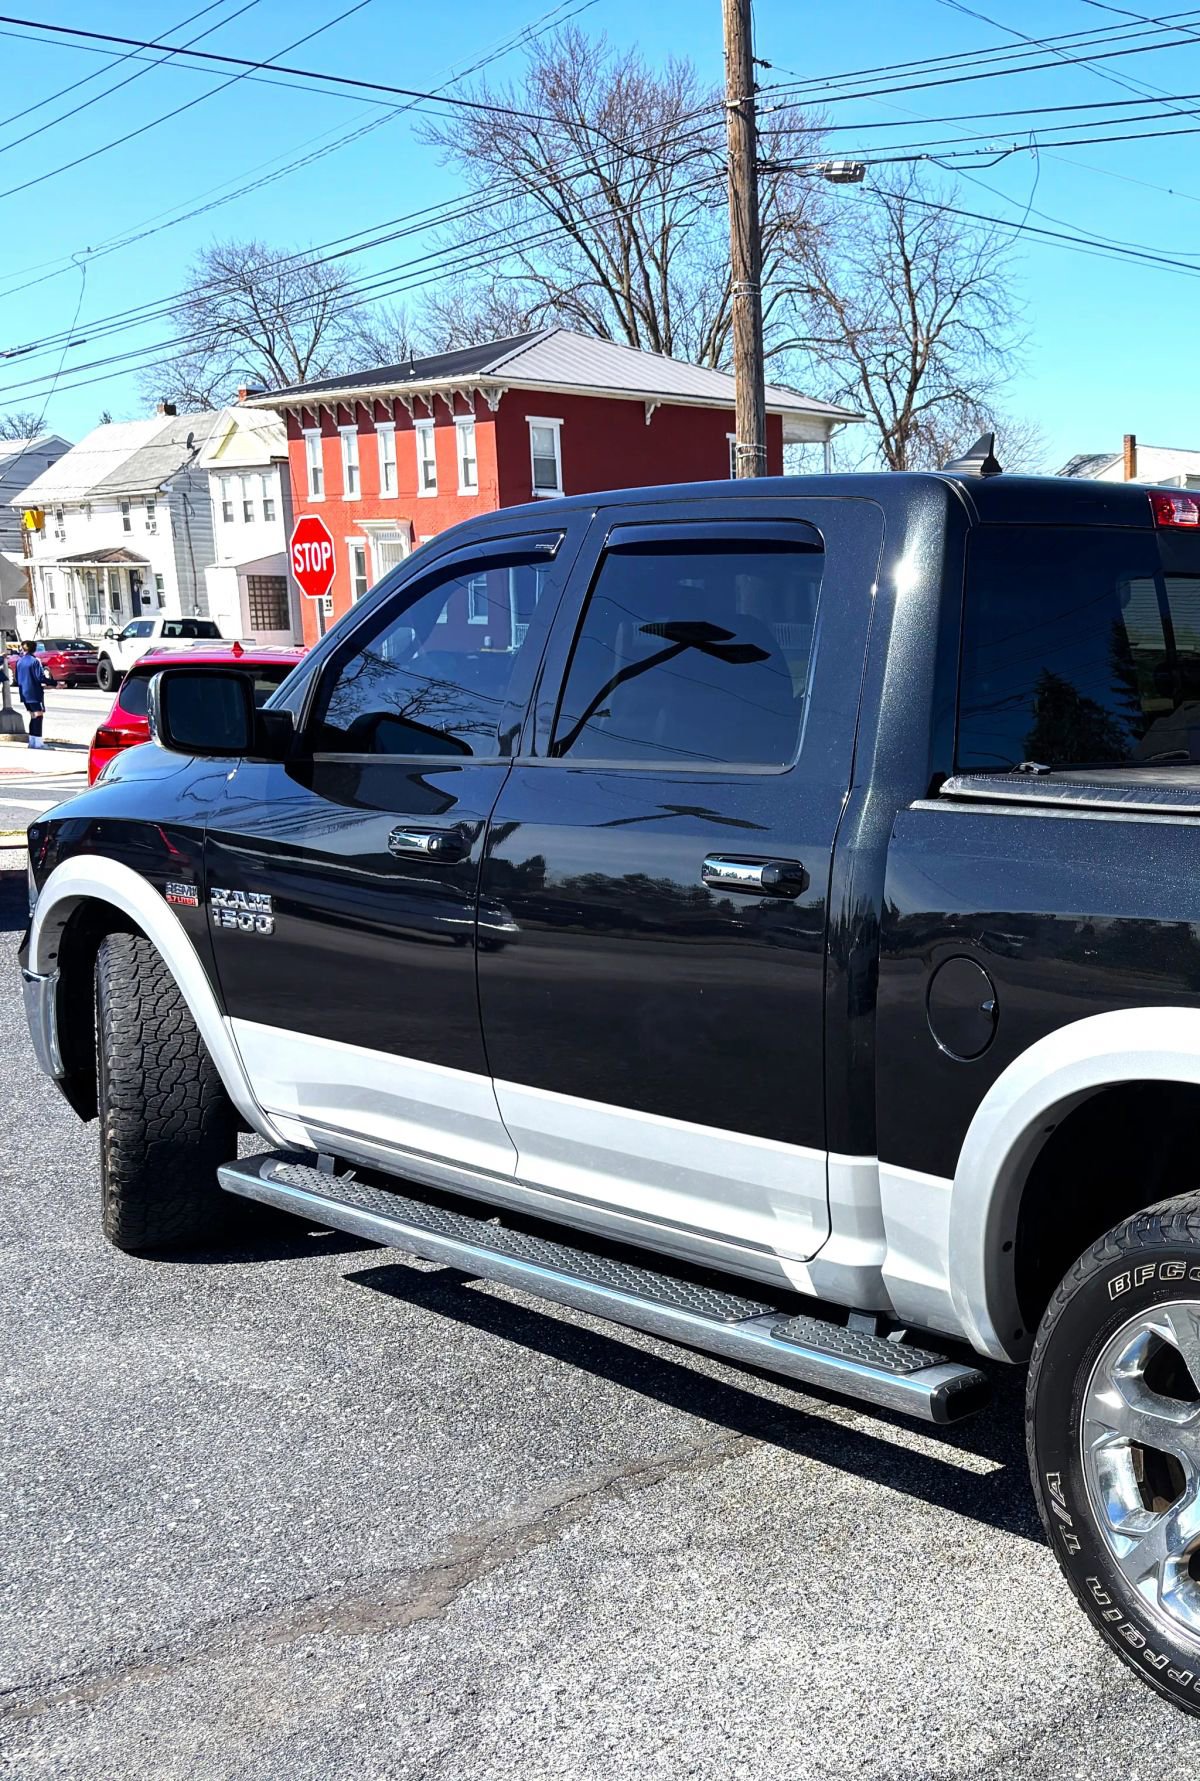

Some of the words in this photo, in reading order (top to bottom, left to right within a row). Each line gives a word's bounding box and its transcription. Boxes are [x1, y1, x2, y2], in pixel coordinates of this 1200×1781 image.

[294, 541, 331, 573] STOP
[210, 887, 272, 914] RAM
[211, 908, 275, 935] 1500
[1045, 1471, 1082, 1556] T/A
